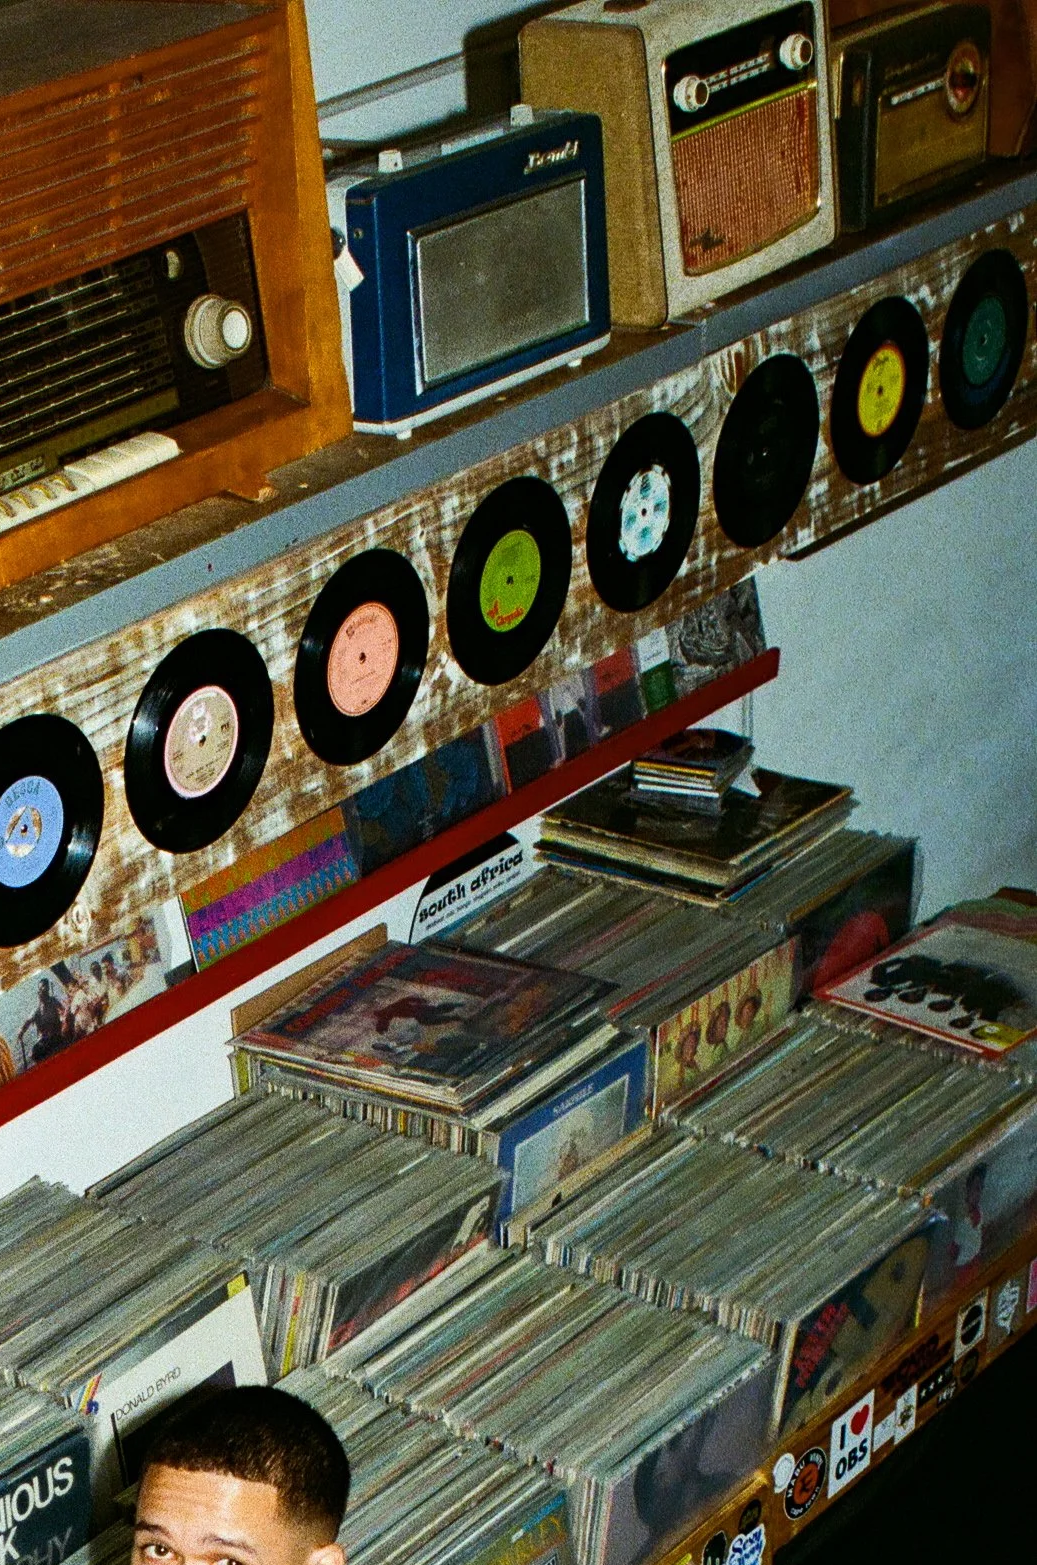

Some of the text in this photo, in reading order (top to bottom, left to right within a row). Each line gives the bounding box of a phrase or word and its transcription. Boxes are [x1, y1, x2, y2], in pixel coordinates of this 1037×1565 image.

[419, 883, 466, 923] south
[470, 849, 523, 891] africa
[115, 1366, 182, 1421] DONALD BYRD
[835, 1437, 868, 1480] OBS
[840, 1423, 847, 1450] I
